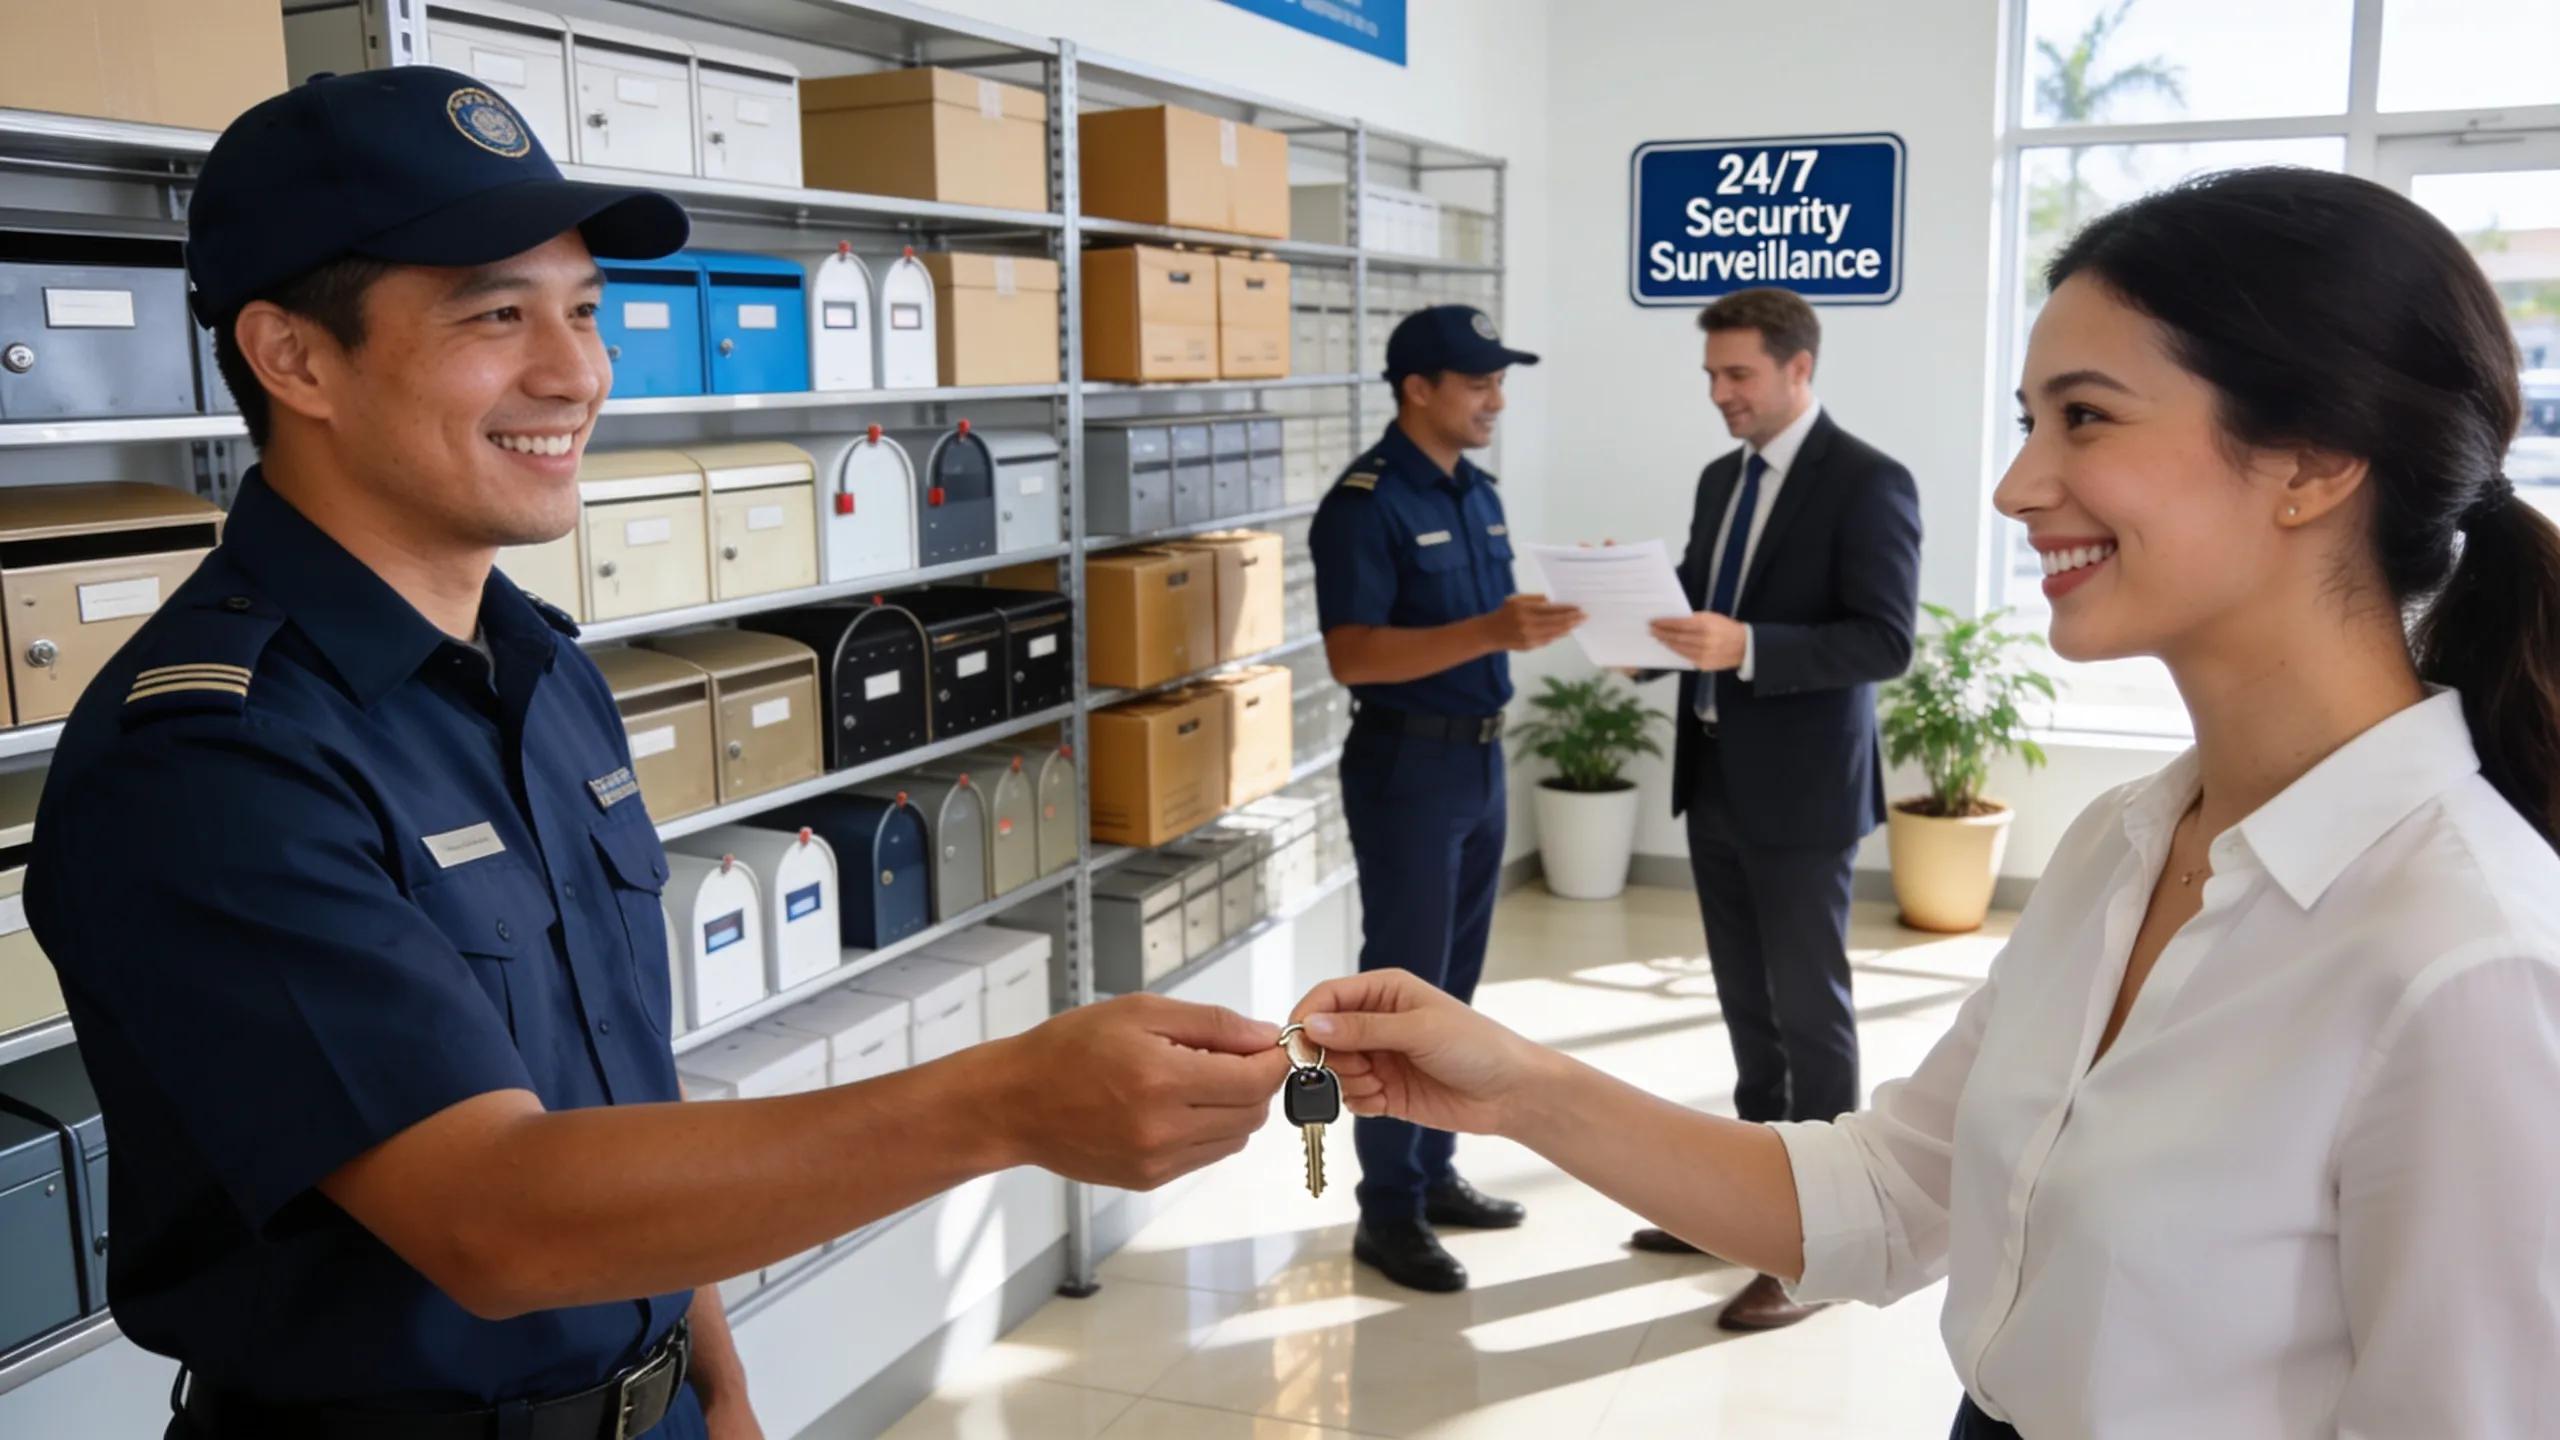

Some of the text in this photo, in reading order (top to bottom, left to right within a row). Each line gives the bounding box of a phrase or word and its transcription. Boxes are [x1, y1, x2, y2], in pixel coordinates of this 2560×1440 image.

[1717, 150, 1818, 195] 24/7
[1686, 197, 1851, 244] Security
[1650, 240, 1881, 281] Surveillance
